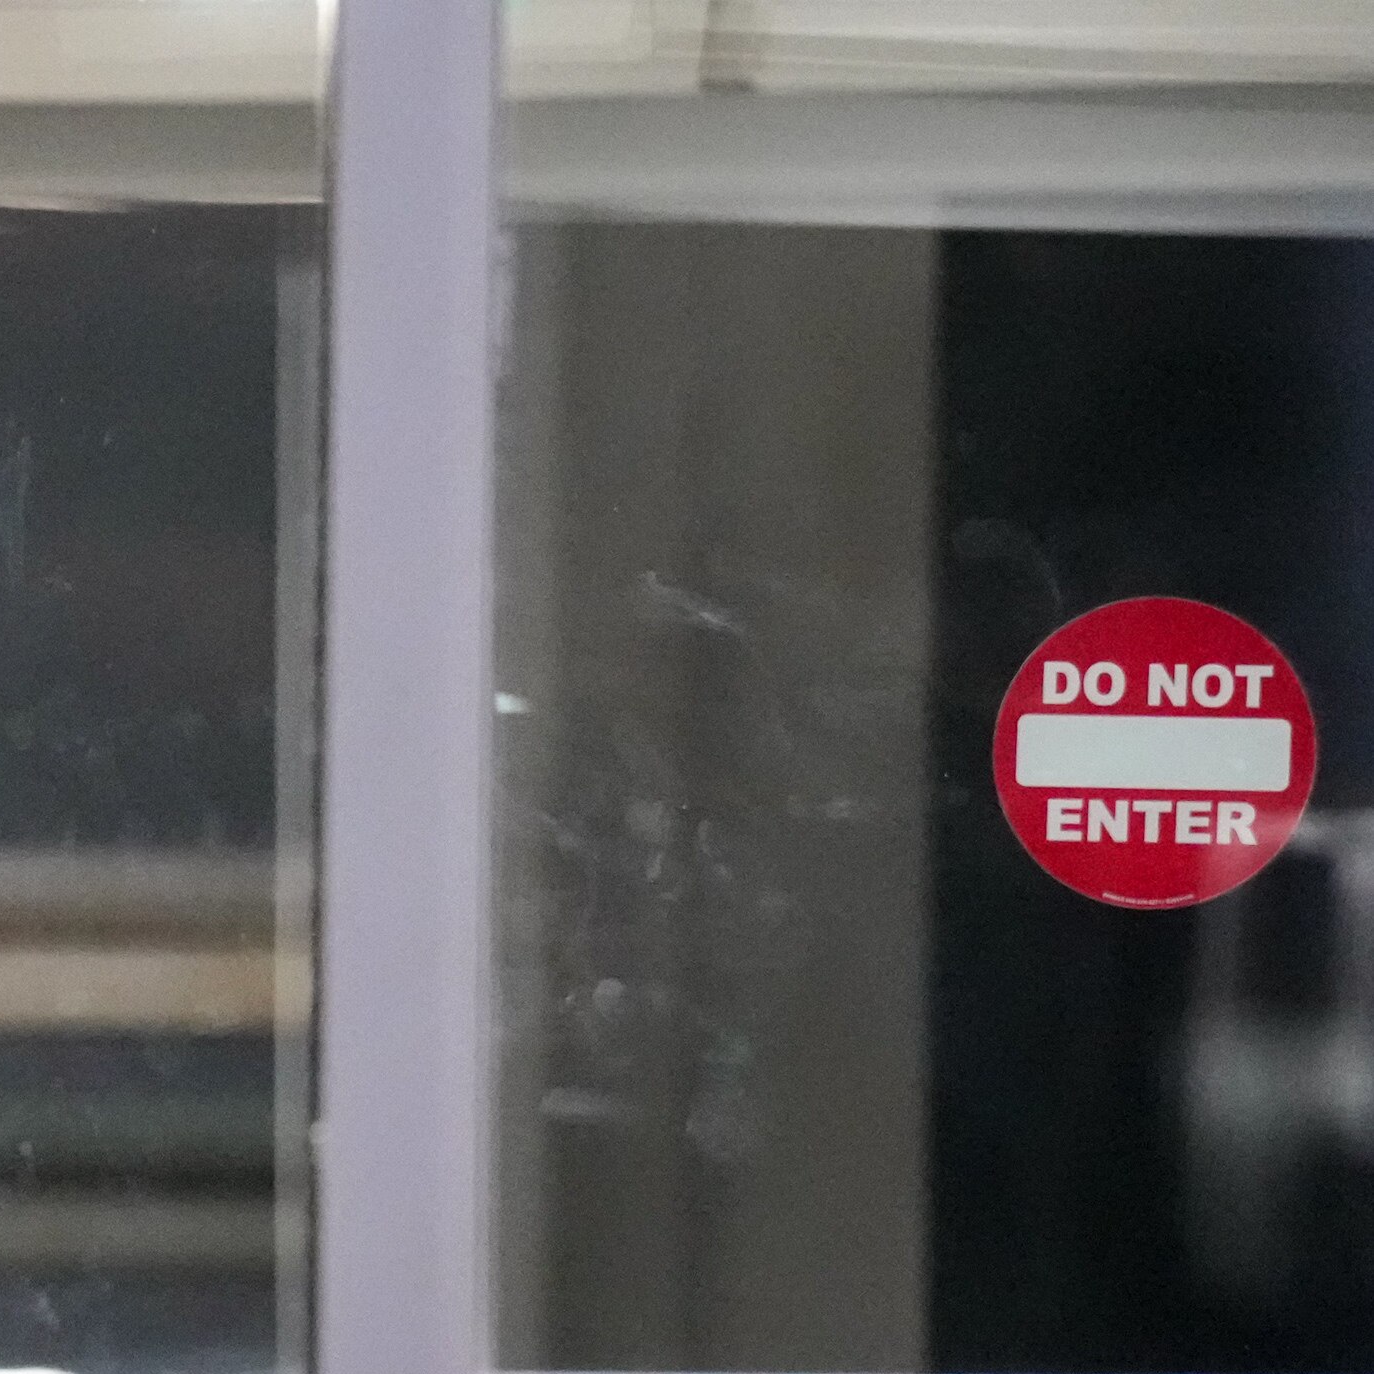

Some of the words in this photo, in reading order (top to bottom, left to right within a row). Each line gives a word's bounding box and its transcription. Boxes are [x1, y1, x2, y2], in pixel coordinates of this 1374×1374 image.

[1042, 661, 1127, 706] DO
[1147, 663, 1274, 709] NOT
[1045, 798, 1258, 846] ENTER
